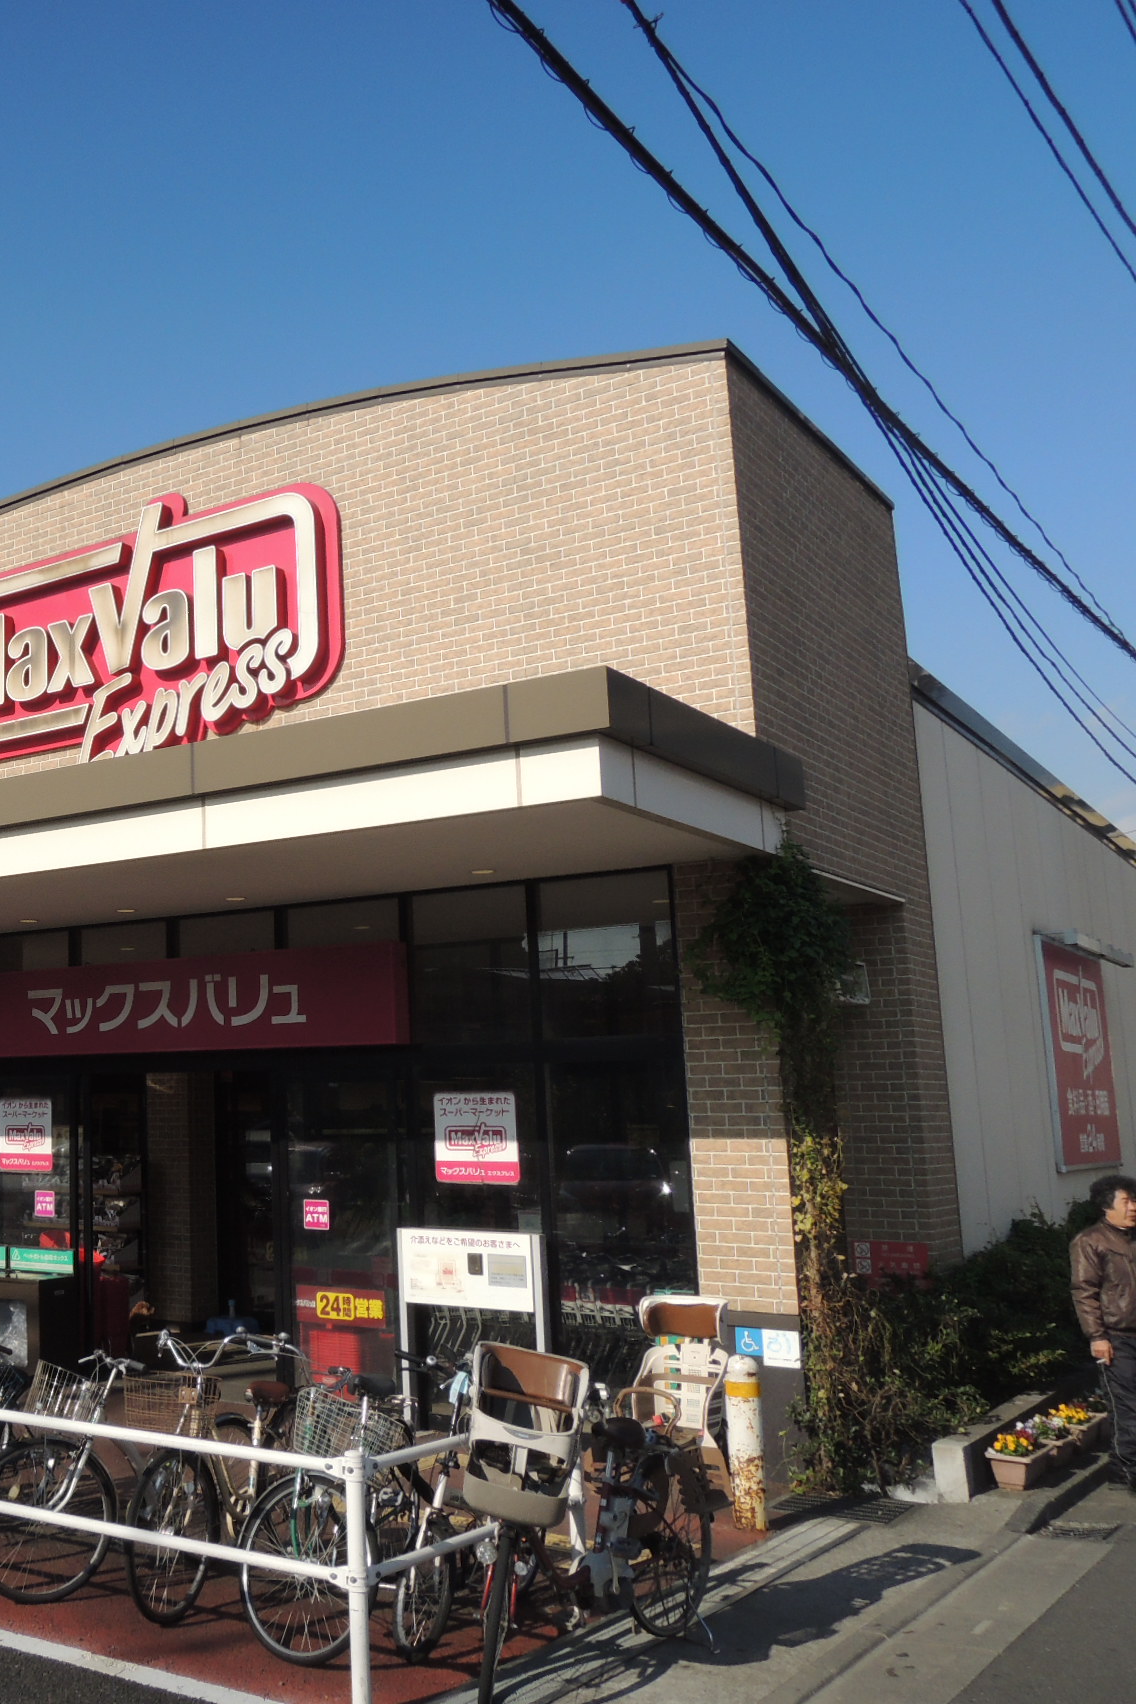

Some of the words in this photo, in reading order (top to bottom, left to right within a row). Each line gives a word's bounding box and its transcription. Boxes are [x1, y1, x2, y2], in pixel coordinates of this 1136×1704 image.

[78, 628, 294, 763] Express
[27, 973, 307, 1034] マックスバリュ
[440, 1107, 510, 1117] スーパーマーケット
[440, 1167, 485, 1176] マックスバリュ
[36, 1203, 53, 1211] ATM
[306, 1213, 328, 1223] ATM
